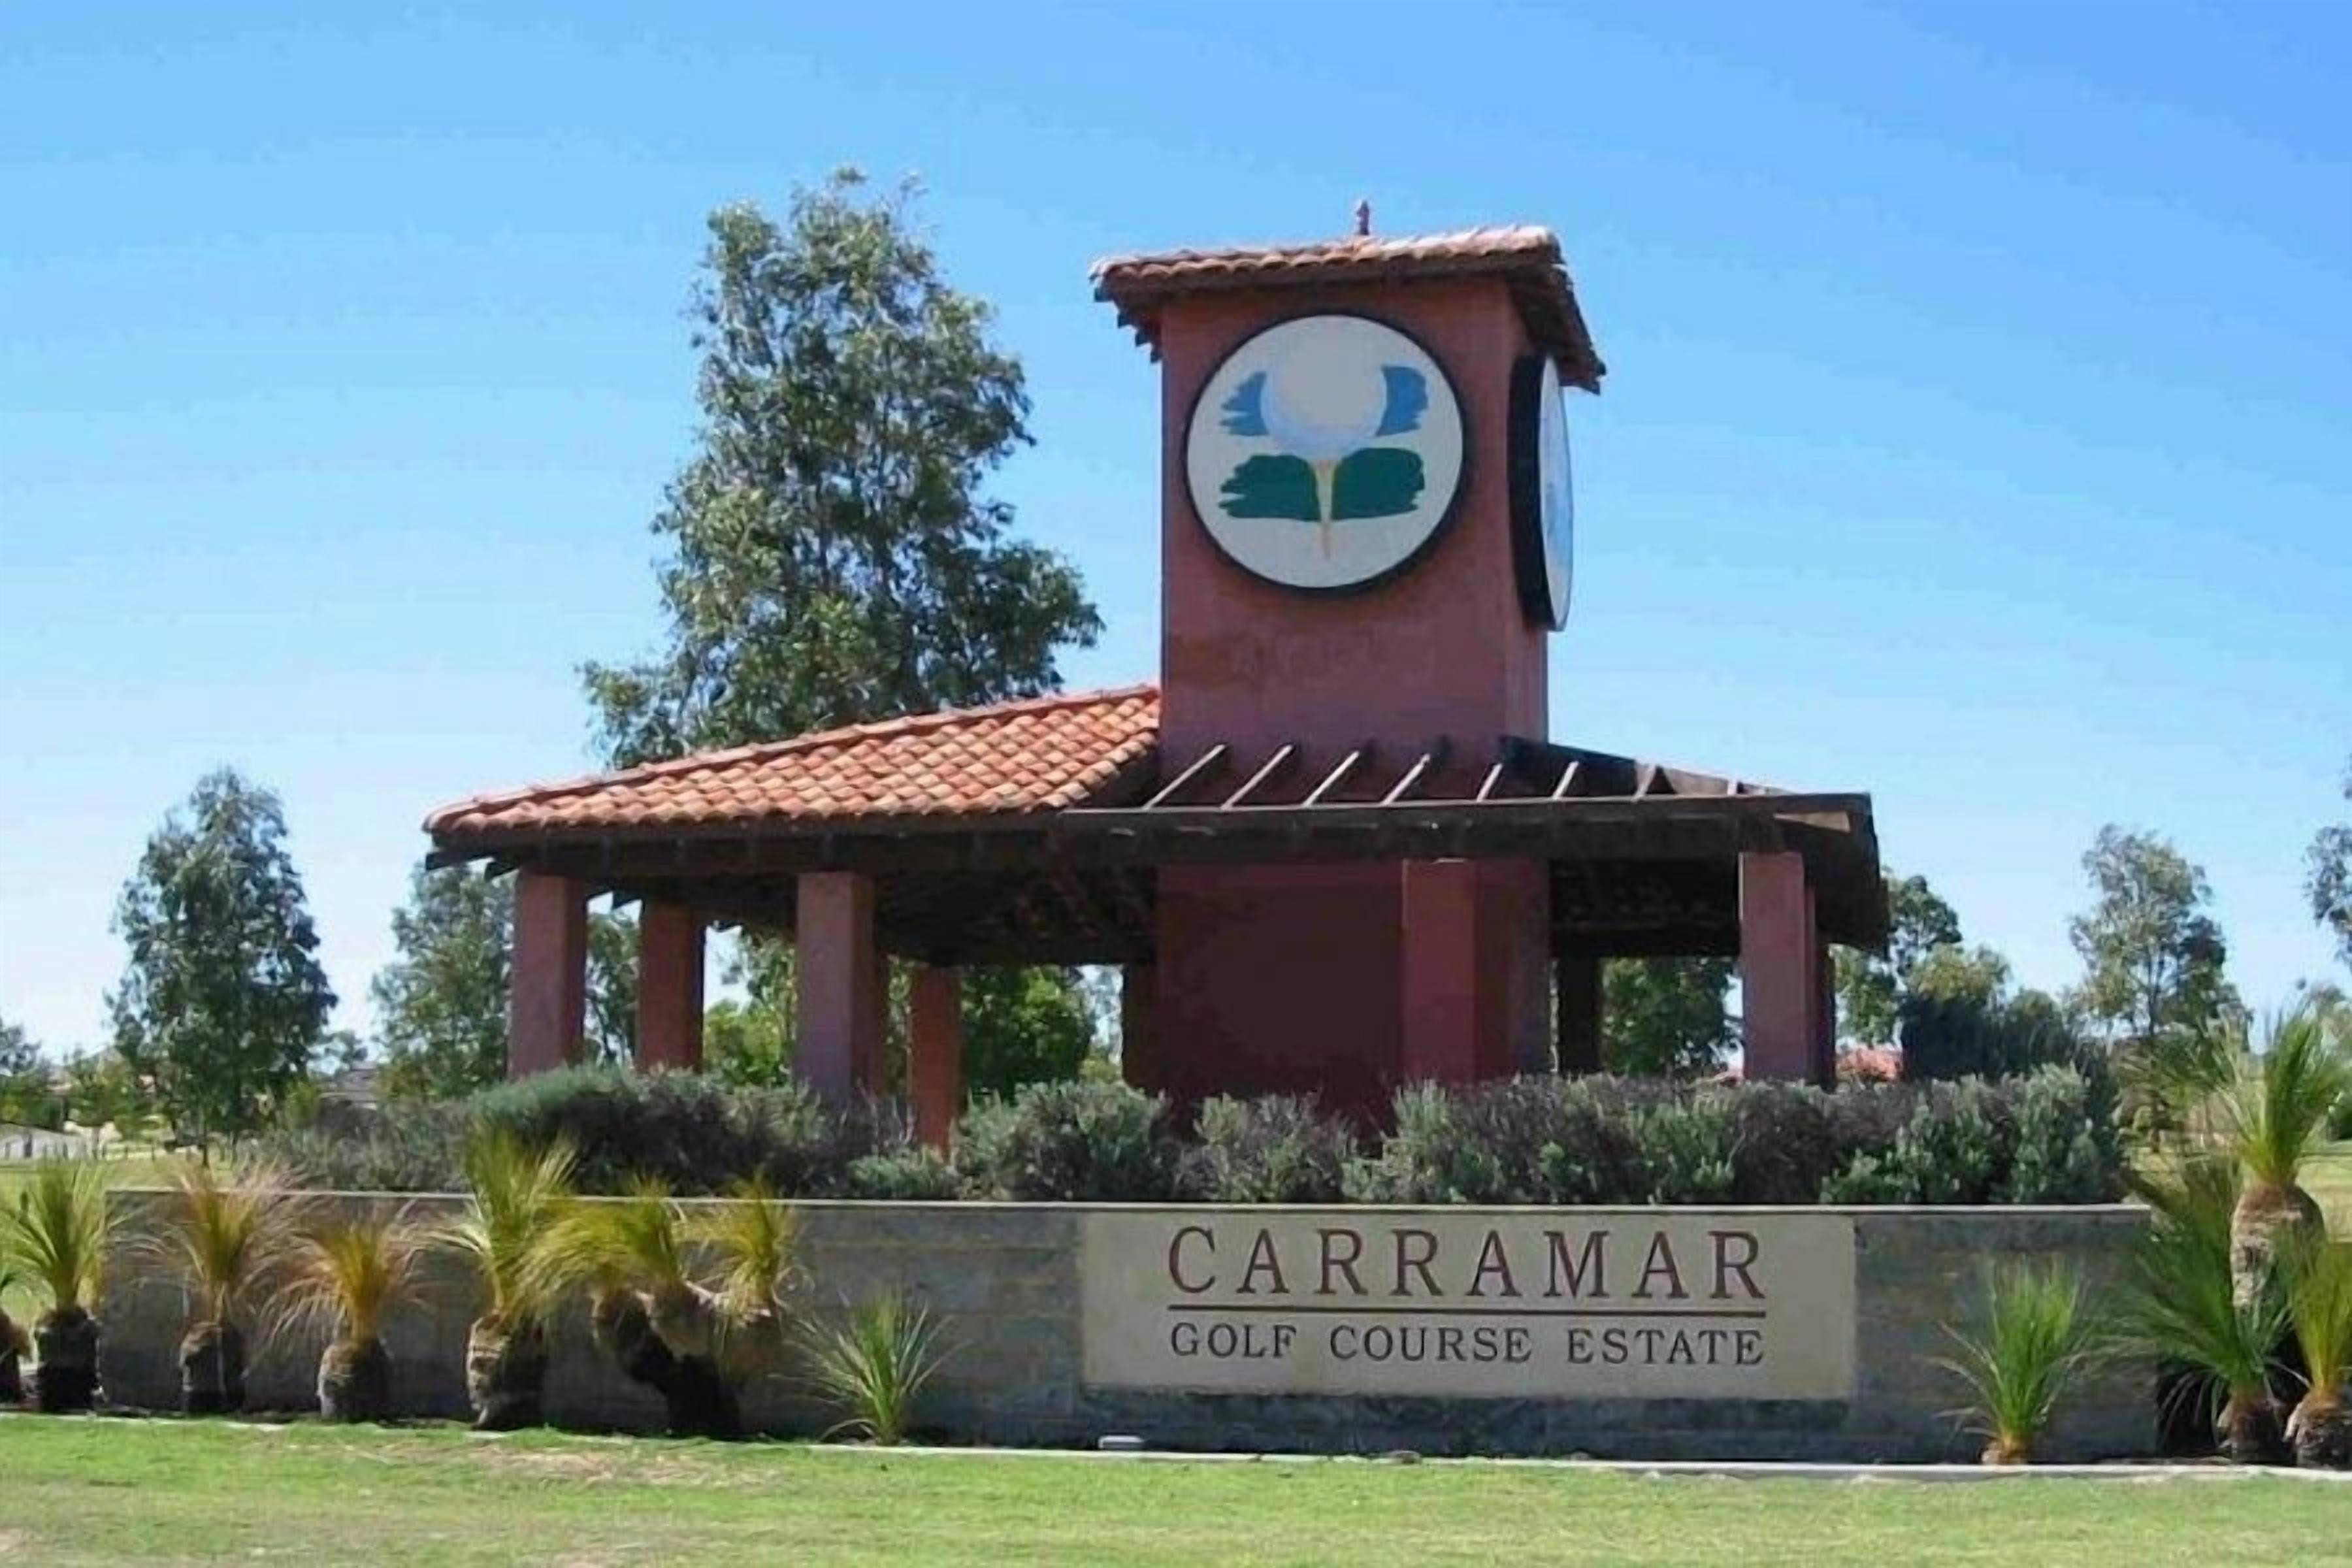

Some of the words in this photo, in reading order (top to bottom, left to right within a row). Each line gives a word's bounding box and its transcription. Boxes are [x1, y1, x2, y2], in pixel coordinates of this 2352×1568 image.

[1169, 1226, 1766, 1300] CARRAMAR
[1171, 1322, 1298, 1359] GOLF
[1330, 1325, 1531, 1363] COURSE
[1567, 1328, 1765, 1367] ESTATE
